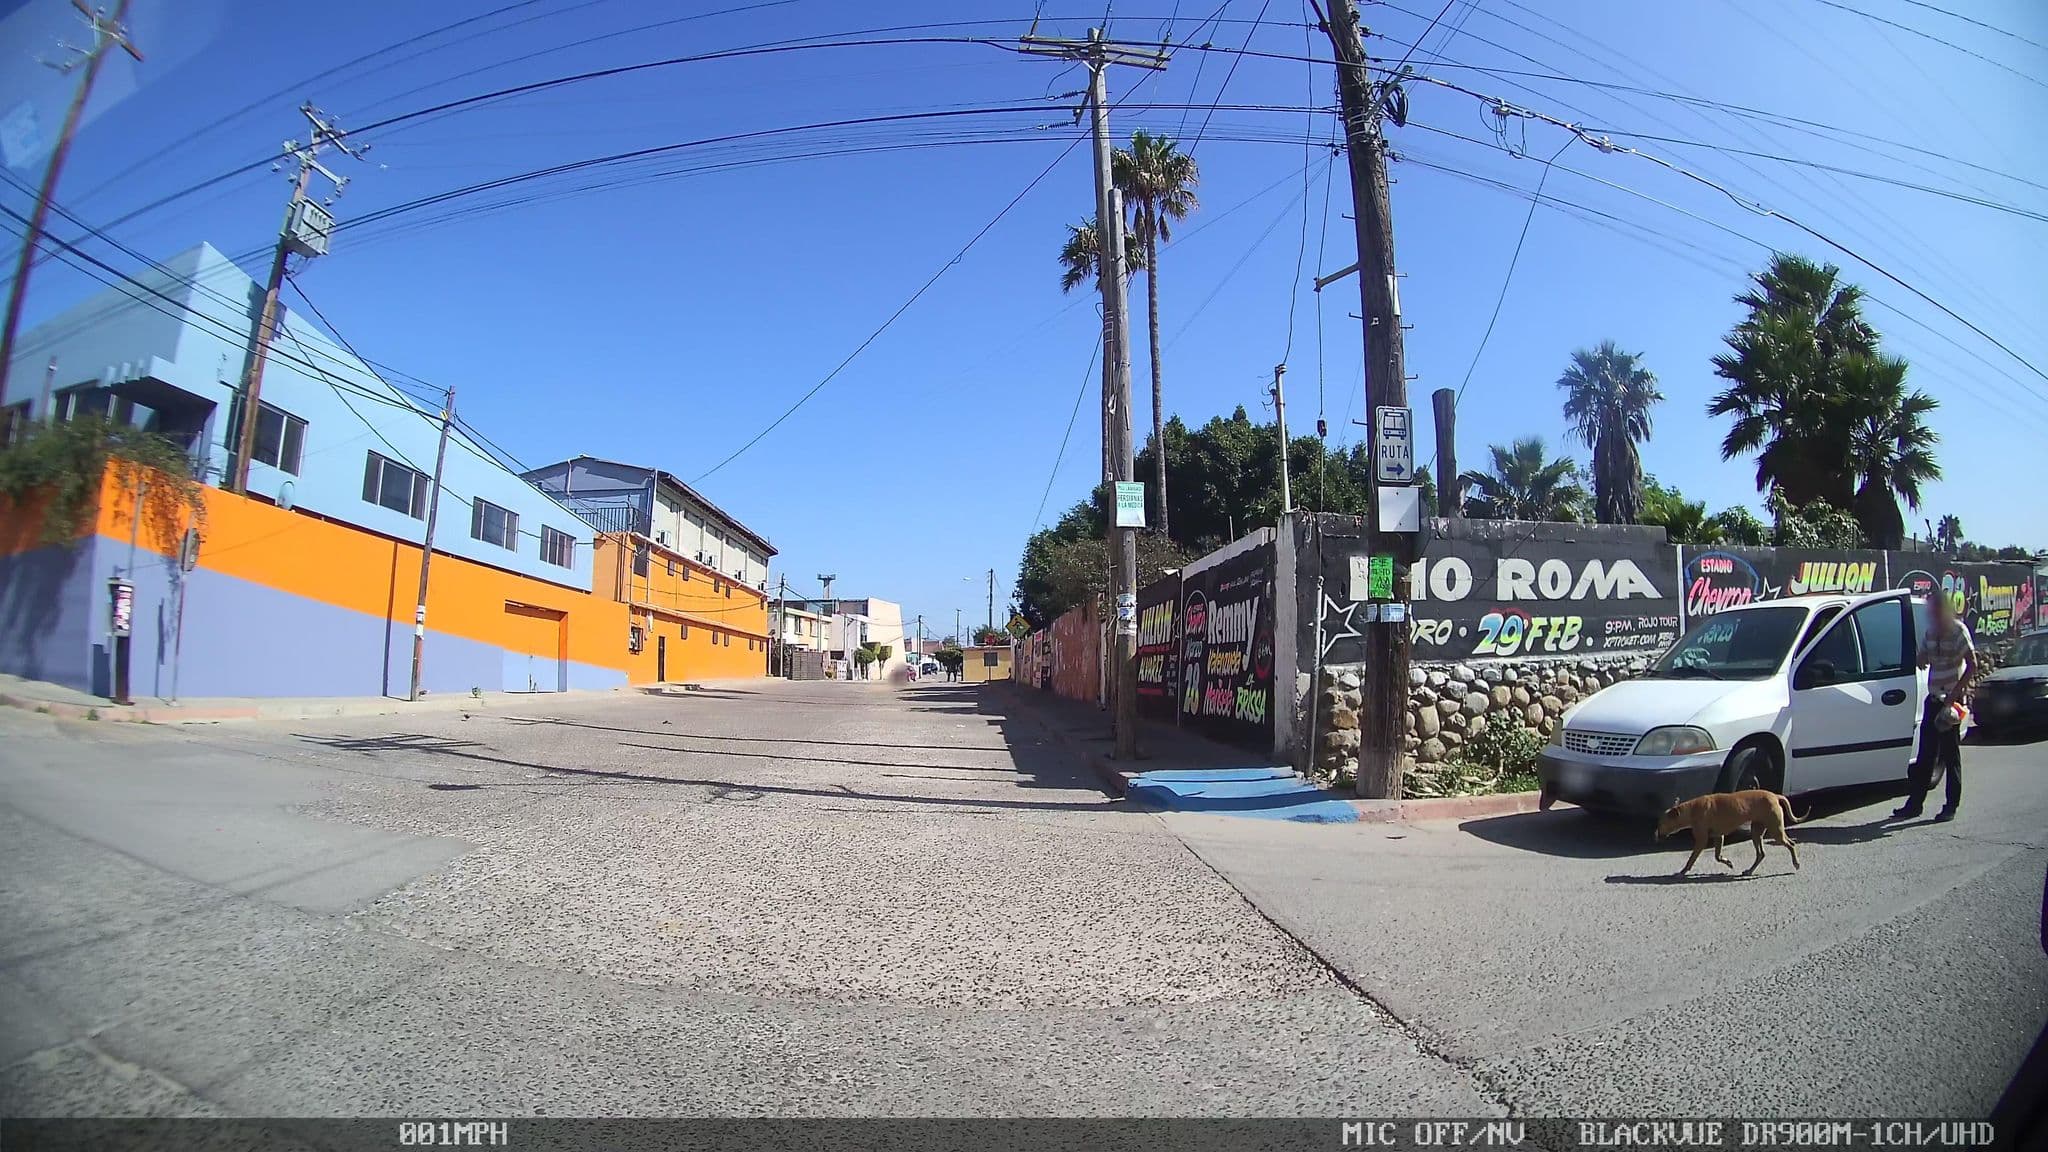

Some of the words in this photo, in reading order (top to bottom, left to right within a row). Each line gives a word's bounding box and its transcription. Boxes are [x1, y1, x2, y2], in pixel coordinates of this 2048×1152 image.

[1381, 445, 1409, 459] RUTA
[1497, 557, 1663, 601] ROMA
[1700, 559, 1734, 574] ESTADIO
[1790, 561, 1877, 596] JULION
[1687, 576, 1752, 617] Chevron
[1138, 599, 1174, 648] JULION
[1207, 595, 1260, 672] Remmy
[1472, 611, 1525, 657] 29
[1638, 615, 1658, 629] ROJO
[1659, 615, 1678, 628] TOUR
[1138, 654, 1165, 684] ALVAREZ
